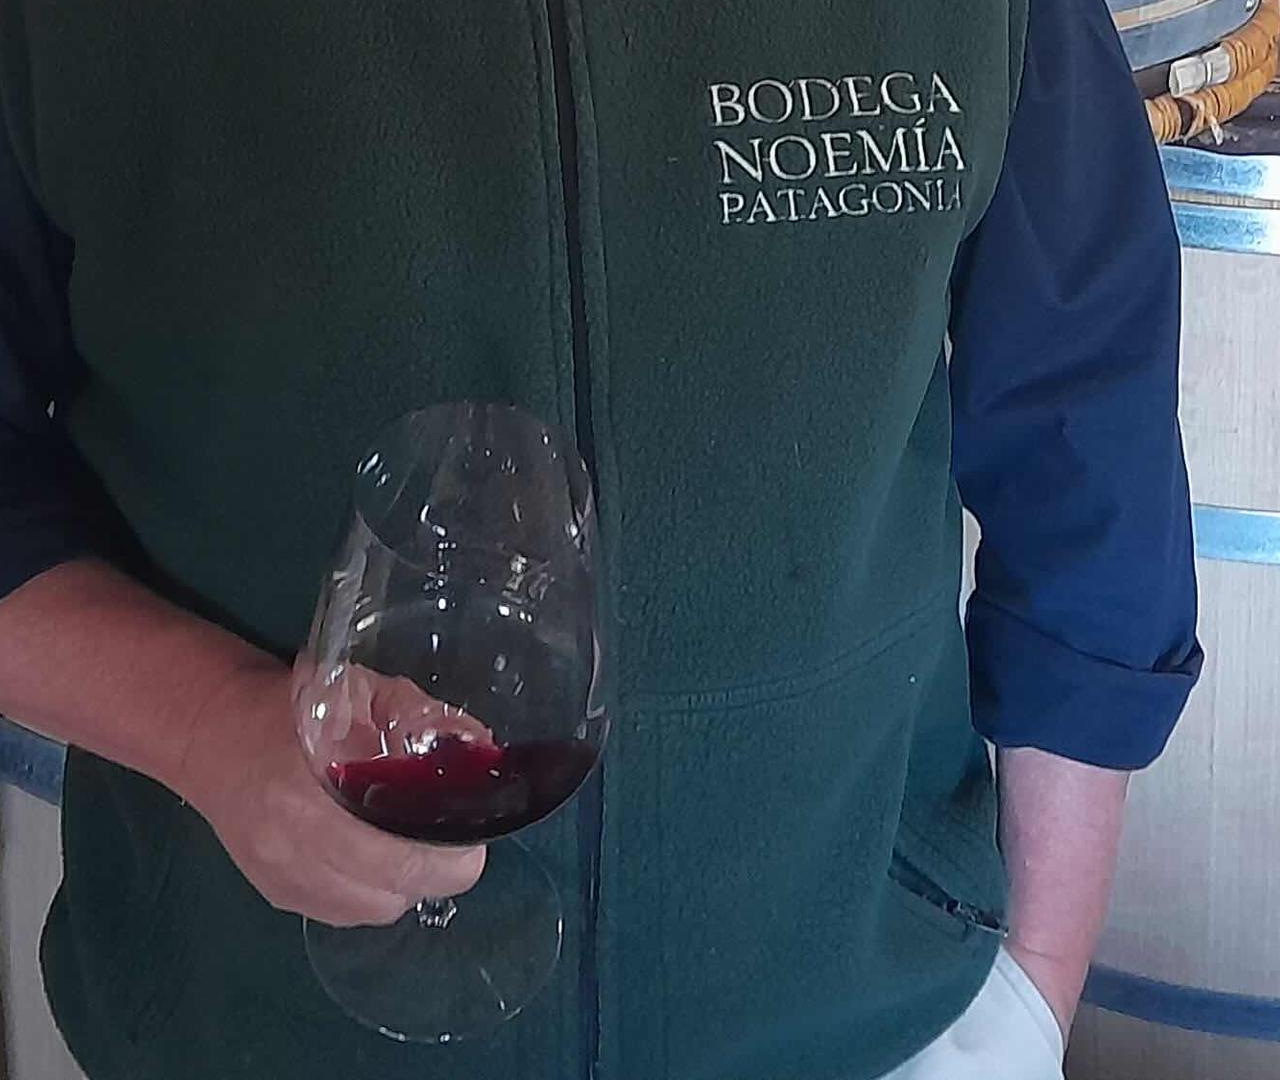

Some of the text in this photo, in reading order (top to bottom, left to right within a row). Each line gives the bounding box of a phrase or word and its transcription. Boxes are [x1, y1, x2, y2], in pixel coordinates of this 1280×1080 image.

[709, 72, 962, 126] BODEGA
[713, 117, 966, 185] NOEMÍA
[719, 178, 963, 224] PATAGONIA
